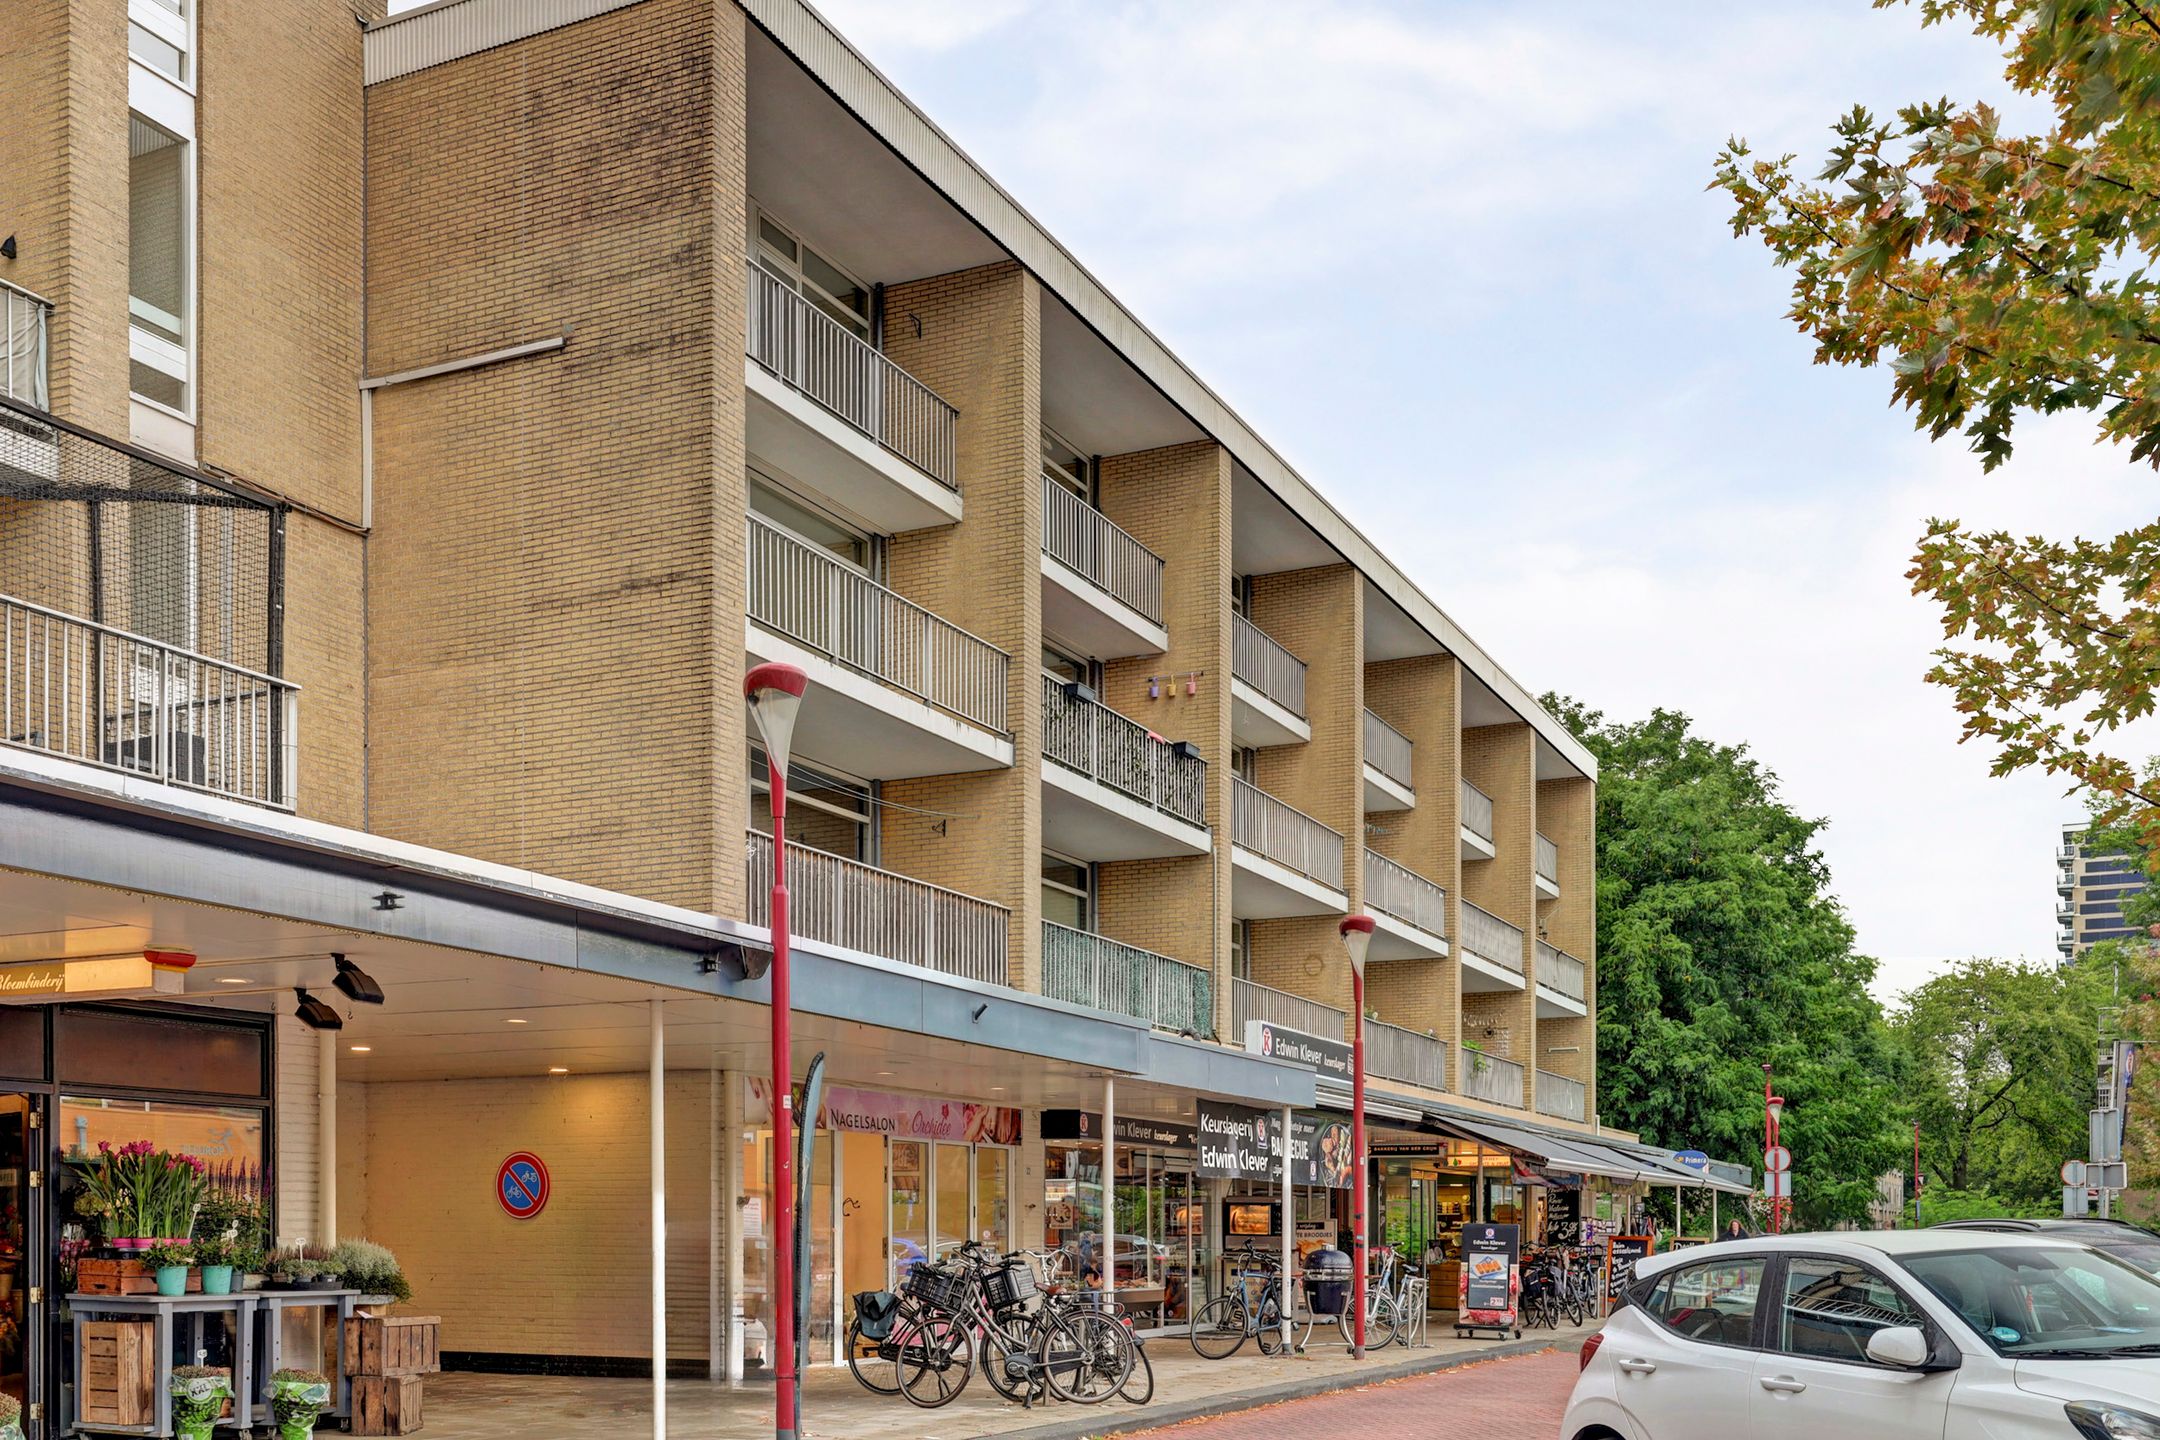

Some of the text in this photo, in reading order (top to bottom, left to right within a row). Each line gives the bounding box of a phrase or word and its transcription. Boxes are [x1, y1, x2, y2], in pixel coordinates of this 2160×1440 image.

[1276, 1037, 1299, 1060] Edwin
[1300, 1043, 1322, 1064] Klever
[1113, 1120, 1126, 1137] win
[1127, 1122, 1152, 1140] Klever
[1201, 1113, 1254, 1143] Keurslagerij
[1201, 1145, 1238, 1169] Edwin
[1238, 1148, 1269, 1172] Klever
[1271, 1135, 1309, 1161] BAECUE
[1685, 1156, 1707, 1164] Primera
